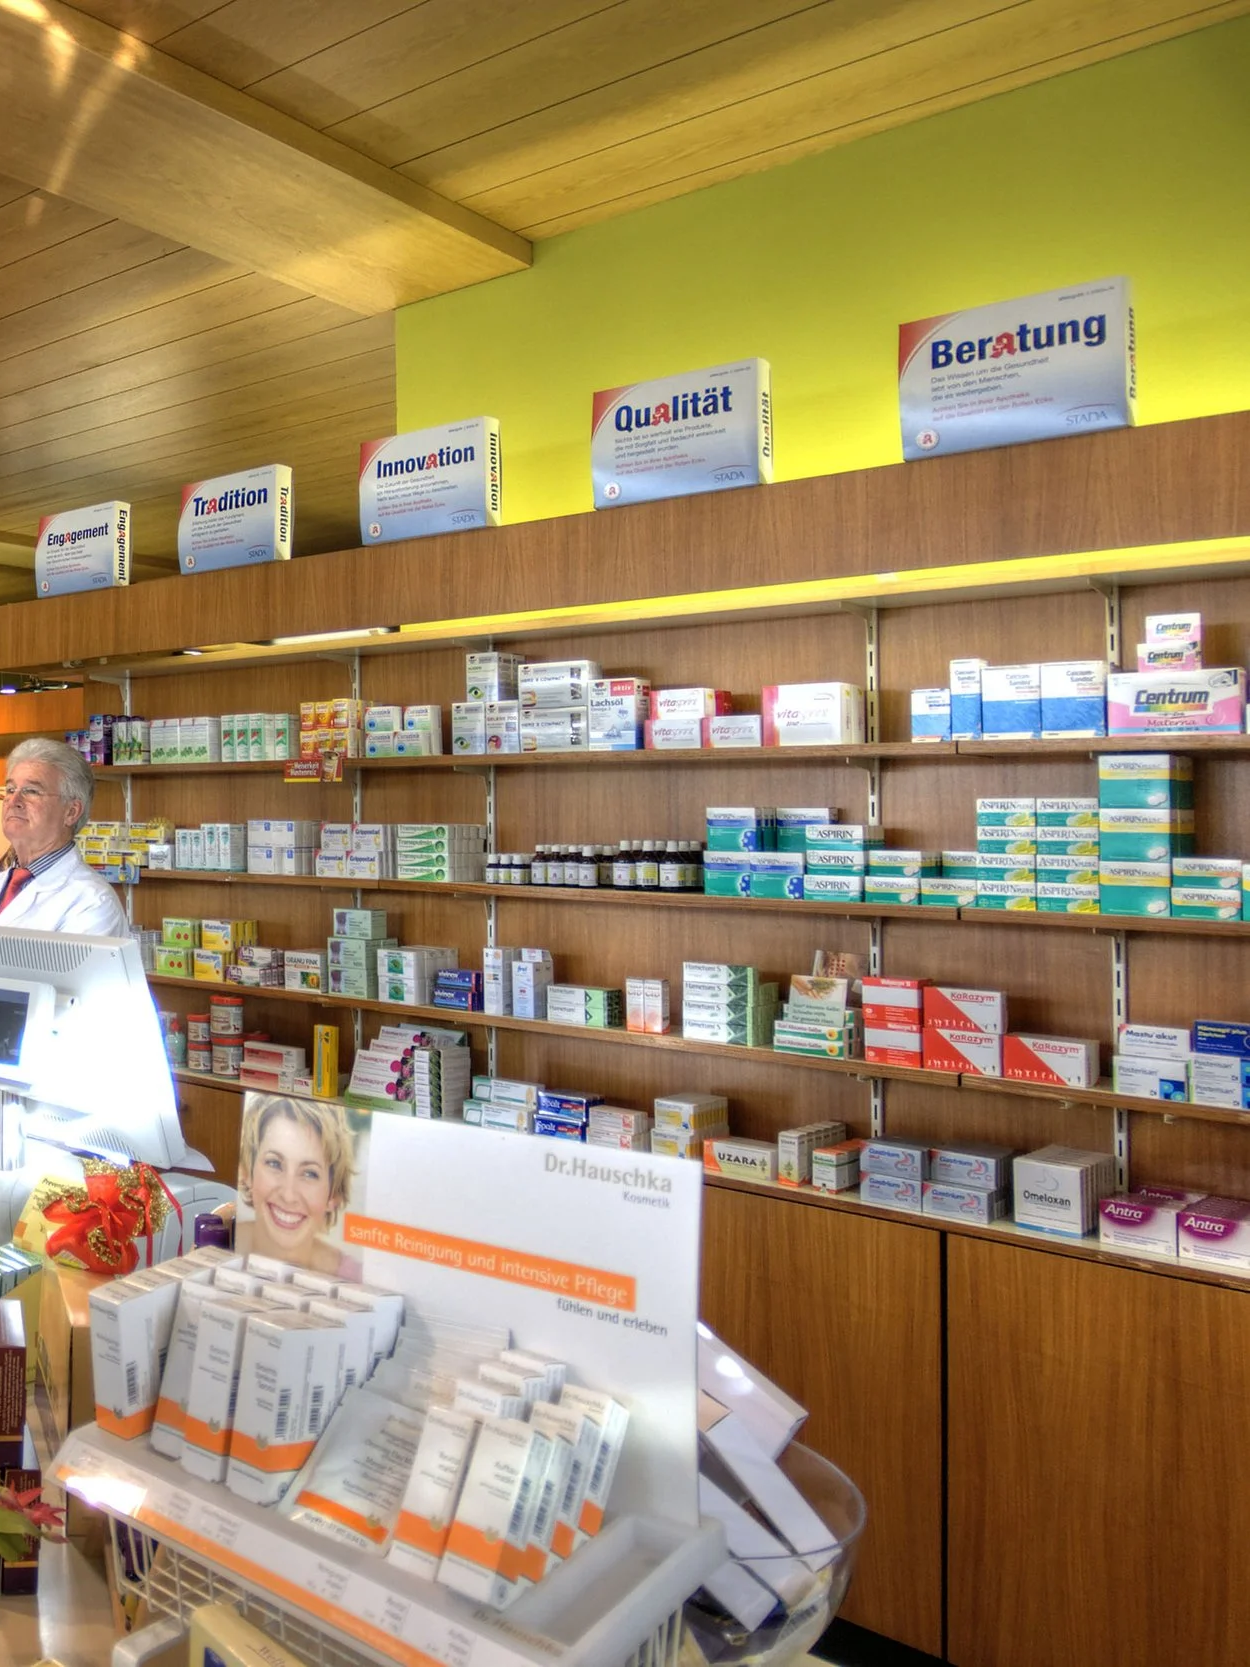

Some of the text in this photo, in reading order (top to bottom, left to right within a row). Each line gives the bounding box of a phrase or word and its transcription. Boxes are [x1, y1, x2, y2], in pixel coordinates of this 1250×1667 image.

[931, 314, 1105, 369] Beratung
[615, 386, 732, 432] Qualität
[1066, 411, 1107, 425] STADA
[377, 446, 475, 479] Innovation
[490, 433, 498, 511] Innovation
[714, 471, 744, 482] STADA
[192, 484, 268, 516] Tradition
[278, 486, 290, 543] Tradition
[48, 523, 109, 547] Engagement
[118, 509, 128, 580] Engagement
[1148, 651, 1184, 660] Centrum
[591, 698, 623, 707] Lachsöl
[1135, 689, 1209, 704] Centrum
[980, 801, 1016, 810] ASPIRIN
[1040, 801, 1077, 810] ASPIRIN
[817, 830, 854, 838] ASPIRIN
[980, 828, 1014, 838] ASPIRIN
[1039, 829, 1077, 839] ASPIRIN
[818, 856, 854, 864] ASPIRIN
[979, 856, 1014, 865] ASPIRIN
[1039, 857, 1078, 867] ASPIRIN
[814, 881, 850, 890] ASPIRIN
[979, 883, 1015, 892] ASPIRIN
[1039, 885, 1078, 895] ASPIRIN
[951, 992, 995, 1003] KaRazym
[950, 1033, 994, 1045] KaRazym
[1126, 1030, 1152, 1038] Mastu
[1032, 1041, 1079, 1054] KaRazym
[540, 1099, 560, 1109] Spalt
[536, 1121, 556, 1132] Spalt
[718, 1152, 757, 1167] UZARA
[544, 1153, 672, 1194] Dr.Hauschka
[623, 1191, 671, 1210] Kosmetik
[1023, 1190, 1071, 1207] Omeloxan
[1105, 1204, 1143, 1219] Antra
[1184, 1217, 1225, 1233] Antra
[350, 1224, 628, 1305] sanfte Reinigung und intensive Pflege
[556, 1297, 668, 1337] fühlen und erleben
